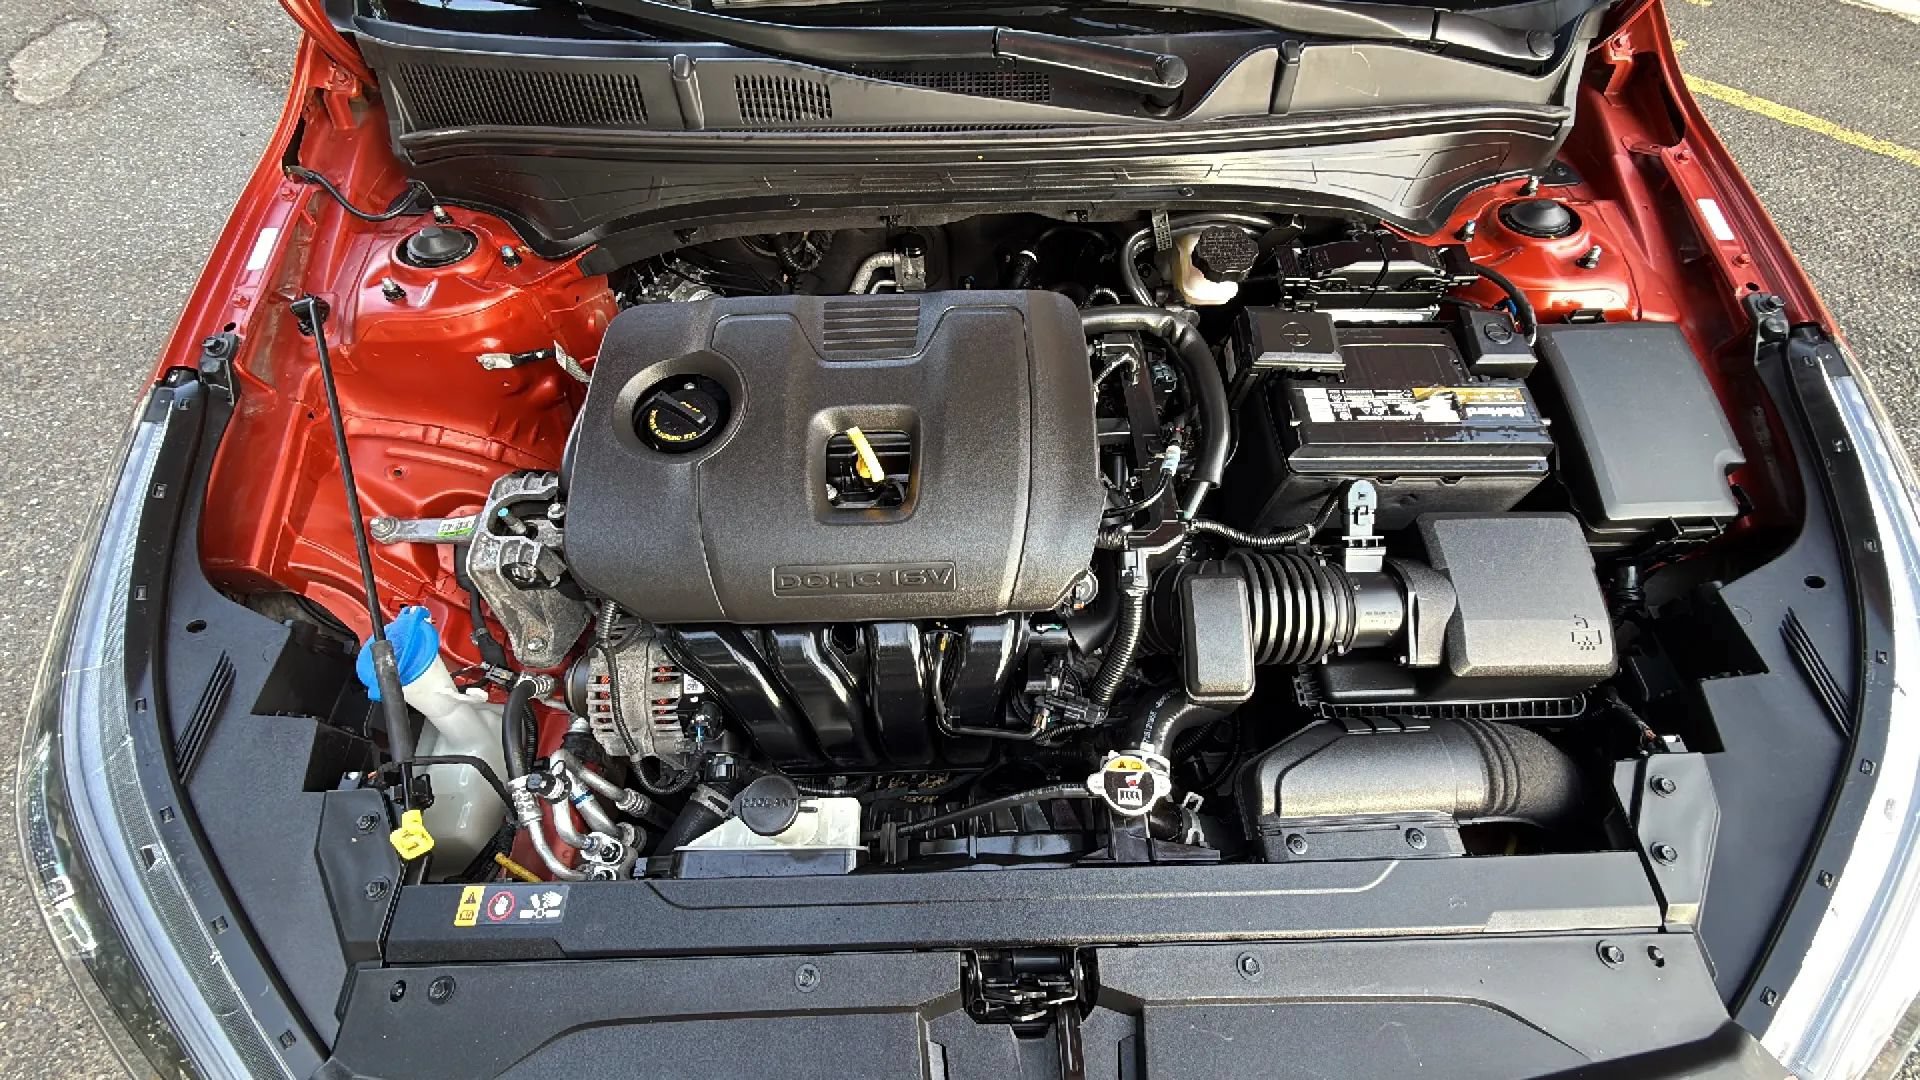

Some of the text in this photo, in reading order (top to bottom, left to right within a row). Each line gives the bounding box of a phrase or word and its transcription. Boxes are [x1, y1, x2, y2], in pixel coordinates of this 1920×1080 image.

[776, 567, 953, 591] DOHC 16V
[741, 797, 797, 809] COOLANT
